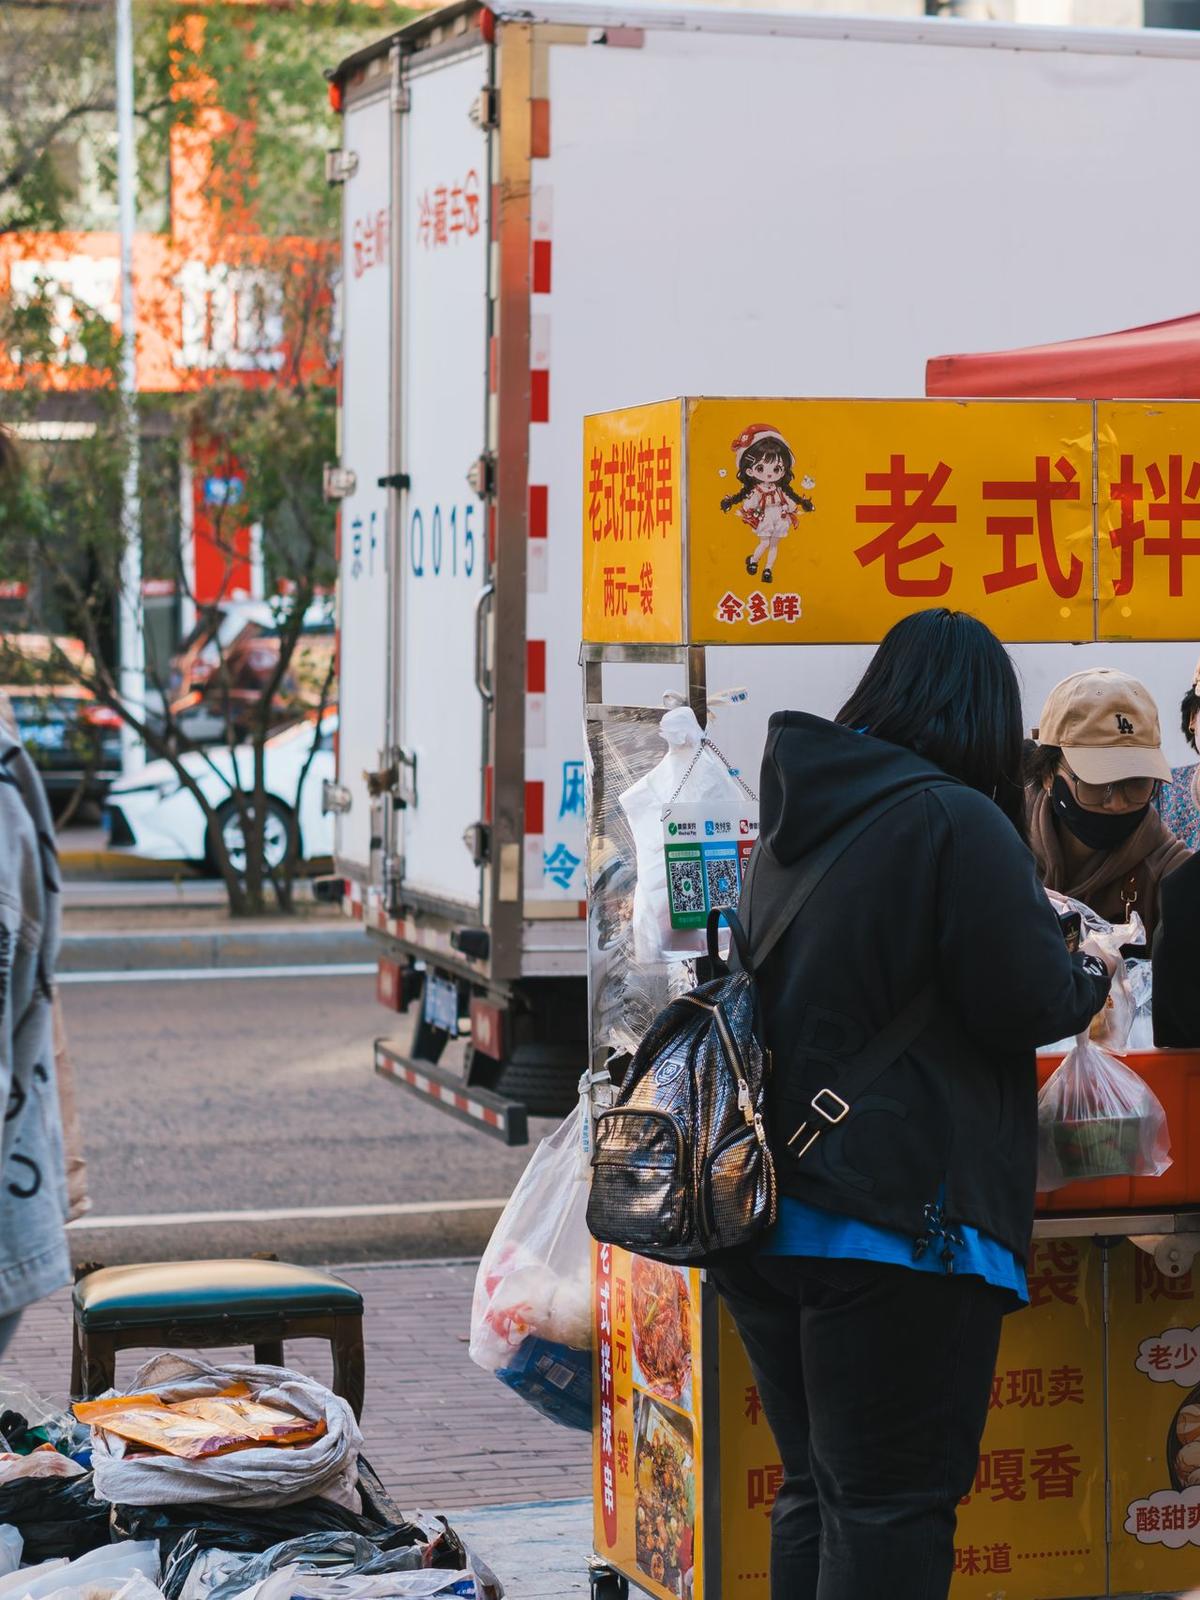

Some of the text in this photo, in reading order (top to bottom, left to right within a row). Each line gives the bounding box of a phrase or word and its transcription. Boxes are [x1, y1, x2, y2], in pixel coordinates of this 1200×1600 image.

[588, 435, 673, 542] 老式拌辣串
[603, 562, 653, 617] 两元一袋
[1115, 713, 1134, 734] LA
[615, 1276, 630, 1478] 两元一袋
